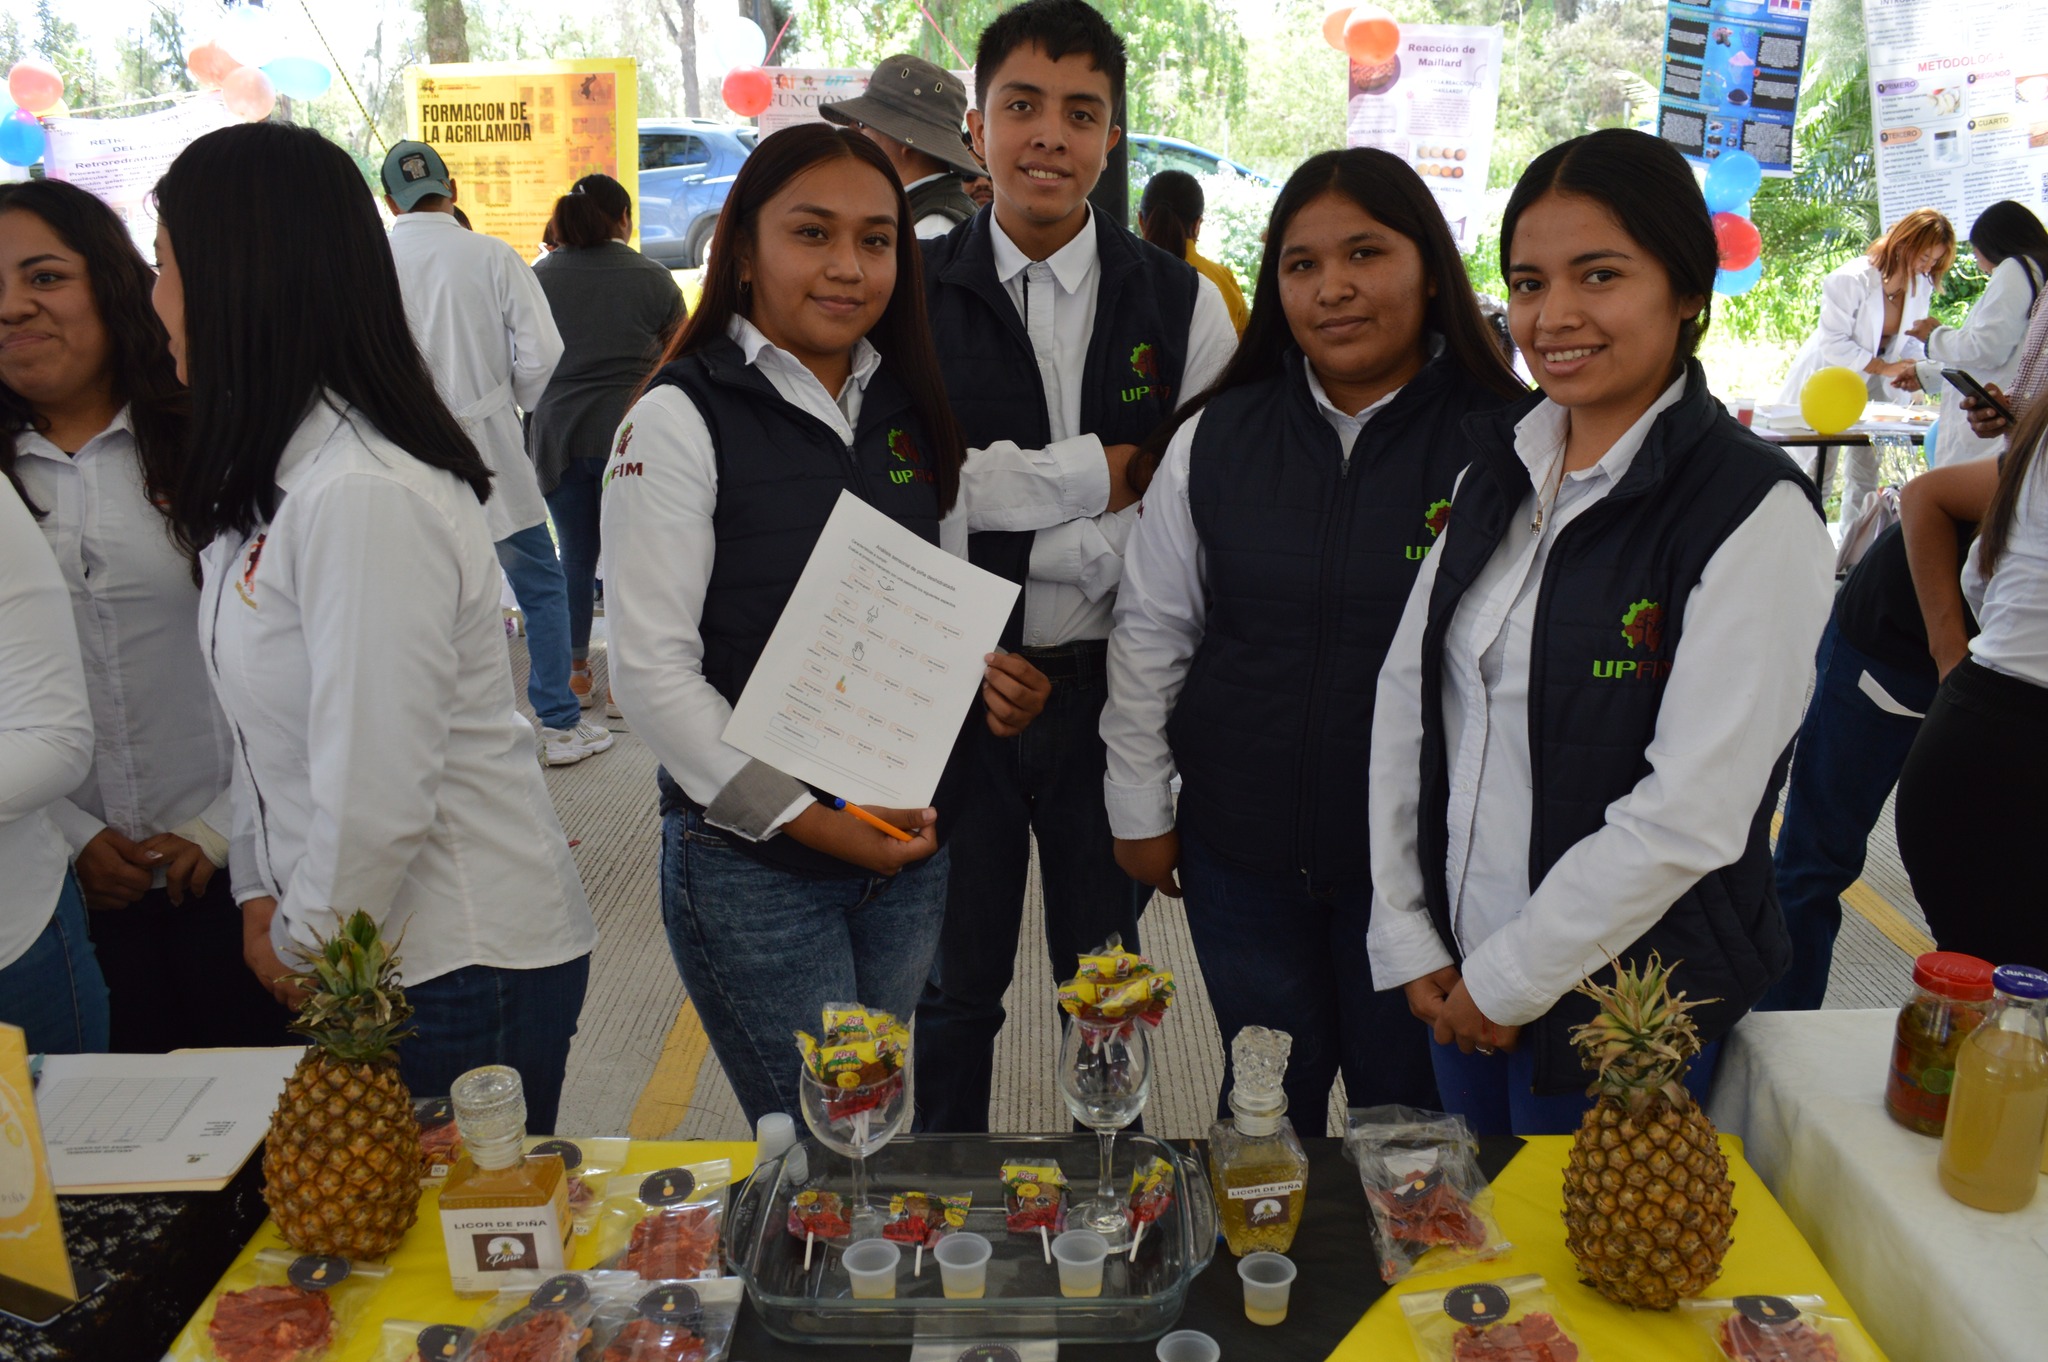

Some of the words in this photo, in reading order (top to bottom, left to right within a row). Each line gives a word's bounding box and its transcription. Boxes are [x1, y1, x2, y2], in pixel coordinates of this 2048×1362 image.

[1408, 43, 1458, 53] Reacción
[1462, 45, 1476, 54] de
[1418, 58, 1462, 68] Maillard
[422, 102, 505, 122] FORMACION
[511, 102, 527, 120] DE
[1978, 116, 2010, 128] CUARTO
[423, 125, 440, 144] LA
[445, 122, 532, 142] ACRILAMIDA
[454, 1222, 494, 1230] LICOR
[516, 1219, 547, 1228] PIÑA
